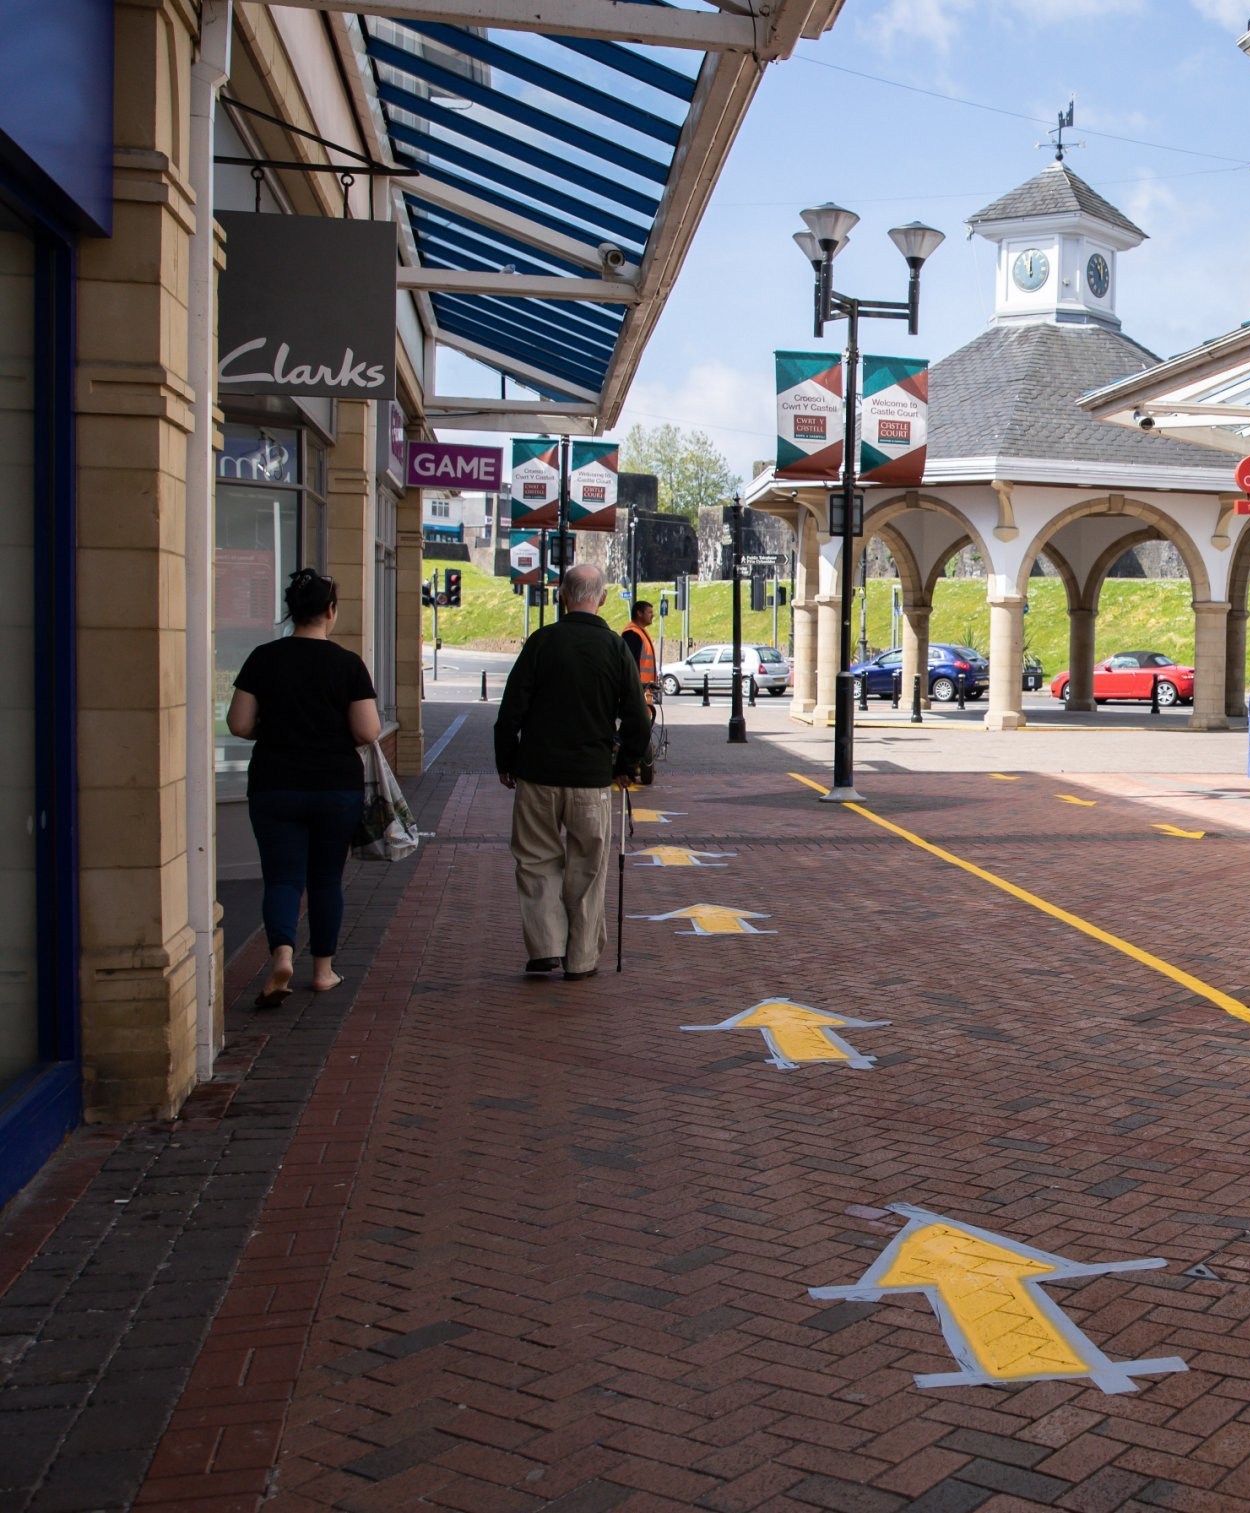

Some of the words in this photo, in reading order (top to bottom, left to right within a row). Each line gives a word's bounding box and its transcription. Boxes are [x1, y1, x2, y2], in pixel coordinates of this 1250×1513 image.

[218, 337, 386, 388] Clarks
[870, 407, 895, 416] Castle
[896, 408, 919, 418] Court
[871, 398, 908, 409] Welcome
[909, 401, 918, 409] to
[413, 453, 496, 481] GAME
